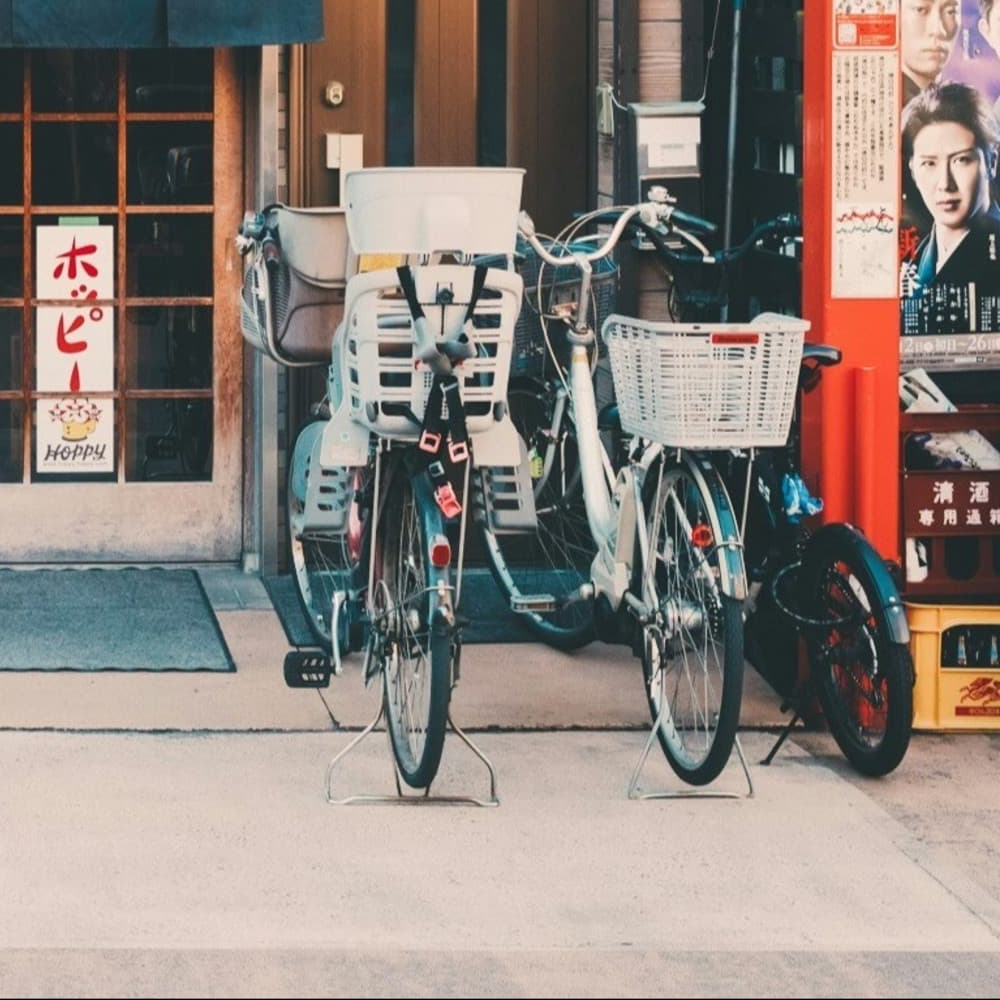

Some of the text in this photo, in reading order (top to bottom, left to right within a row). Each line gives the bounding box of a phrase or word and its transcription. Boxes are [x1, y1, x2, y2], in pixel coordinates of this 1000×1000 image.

[52, 234, 104, 393] ホッピー
[932, 481, 990, 504] 清酒
